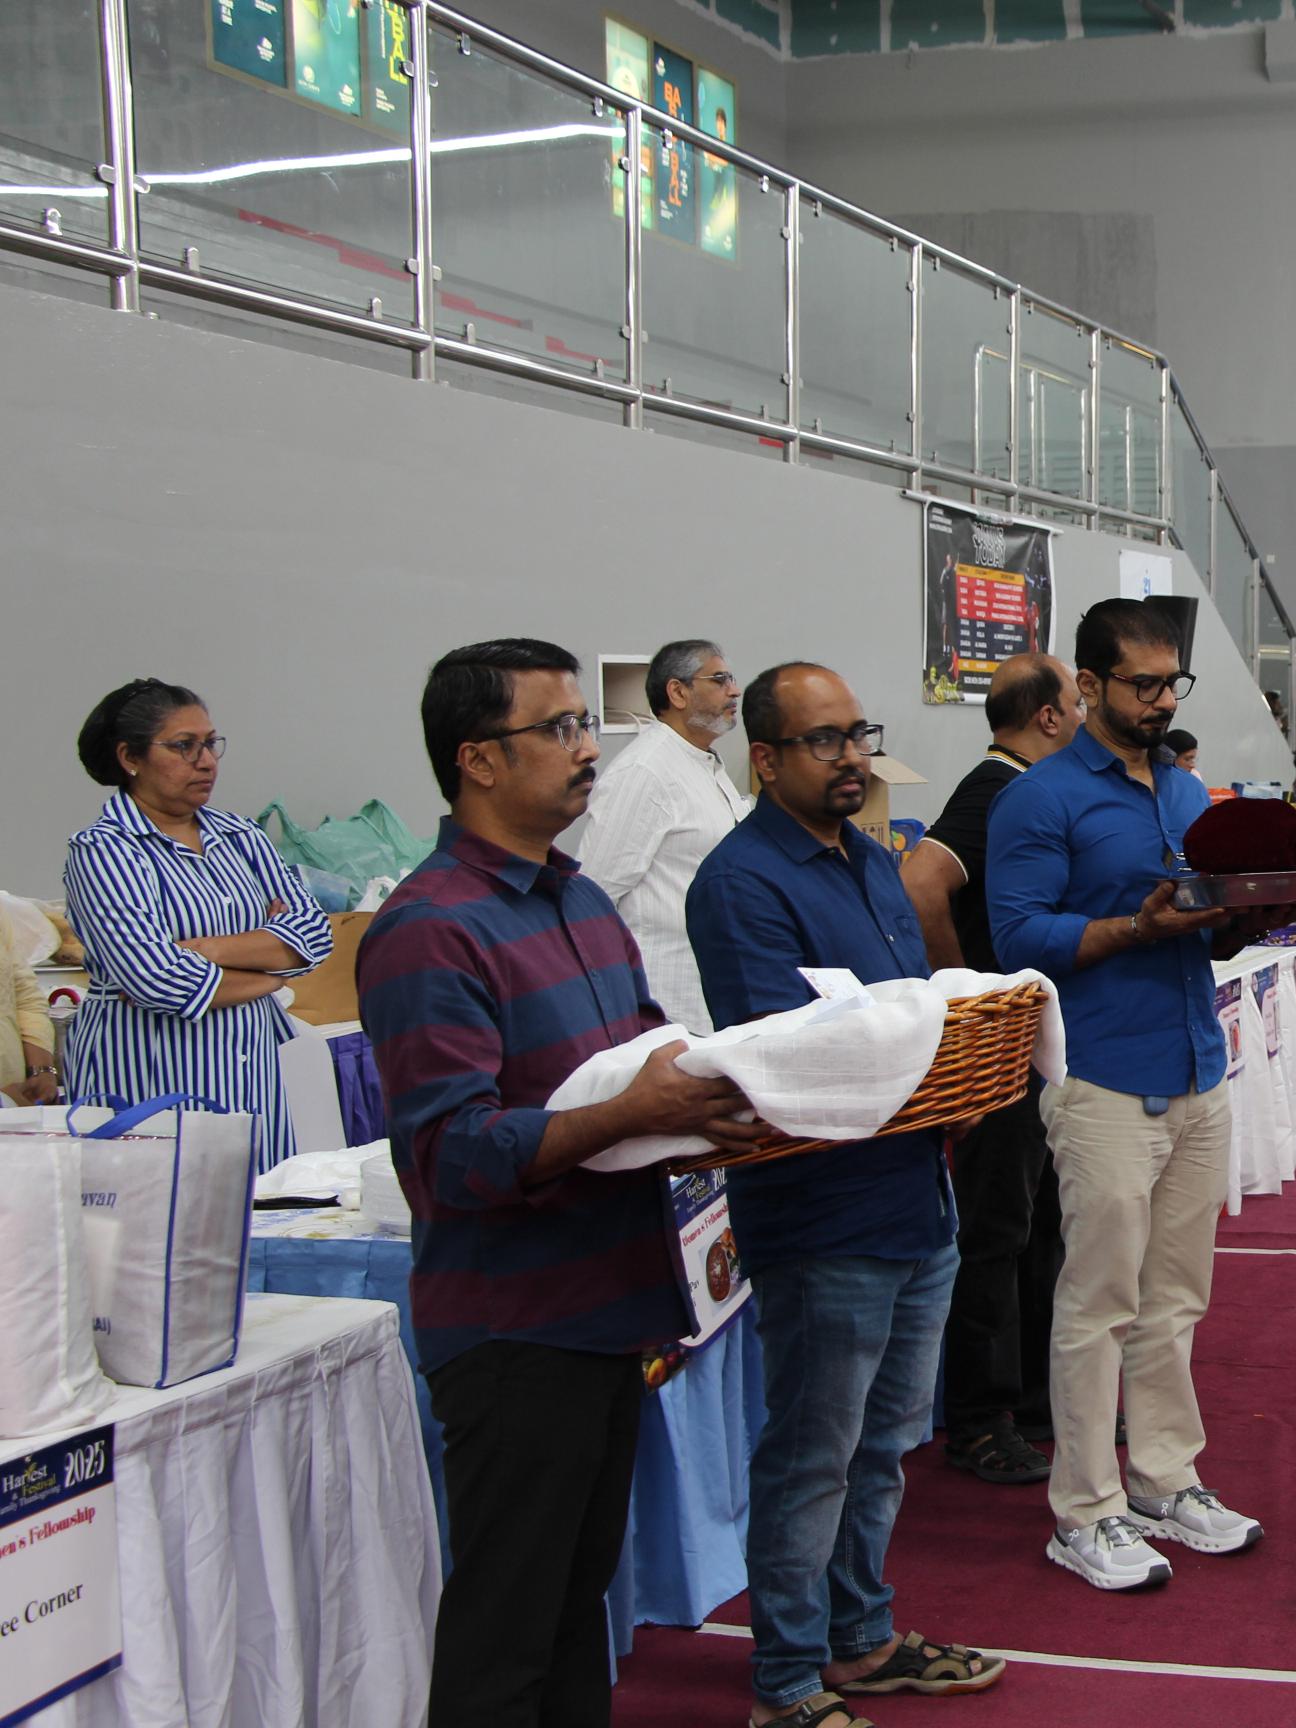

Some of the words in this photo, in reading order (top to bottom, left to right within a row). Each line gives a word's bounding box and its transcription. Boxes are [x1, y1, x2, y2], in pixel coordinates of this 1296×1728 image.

[3, 1464, 48, 1493] Harvest
[64, 1440, 105, 1488] 2025
[29, 1506, 96, 1545] Fellowship
[24, 1584, 84, 1623] Corner
